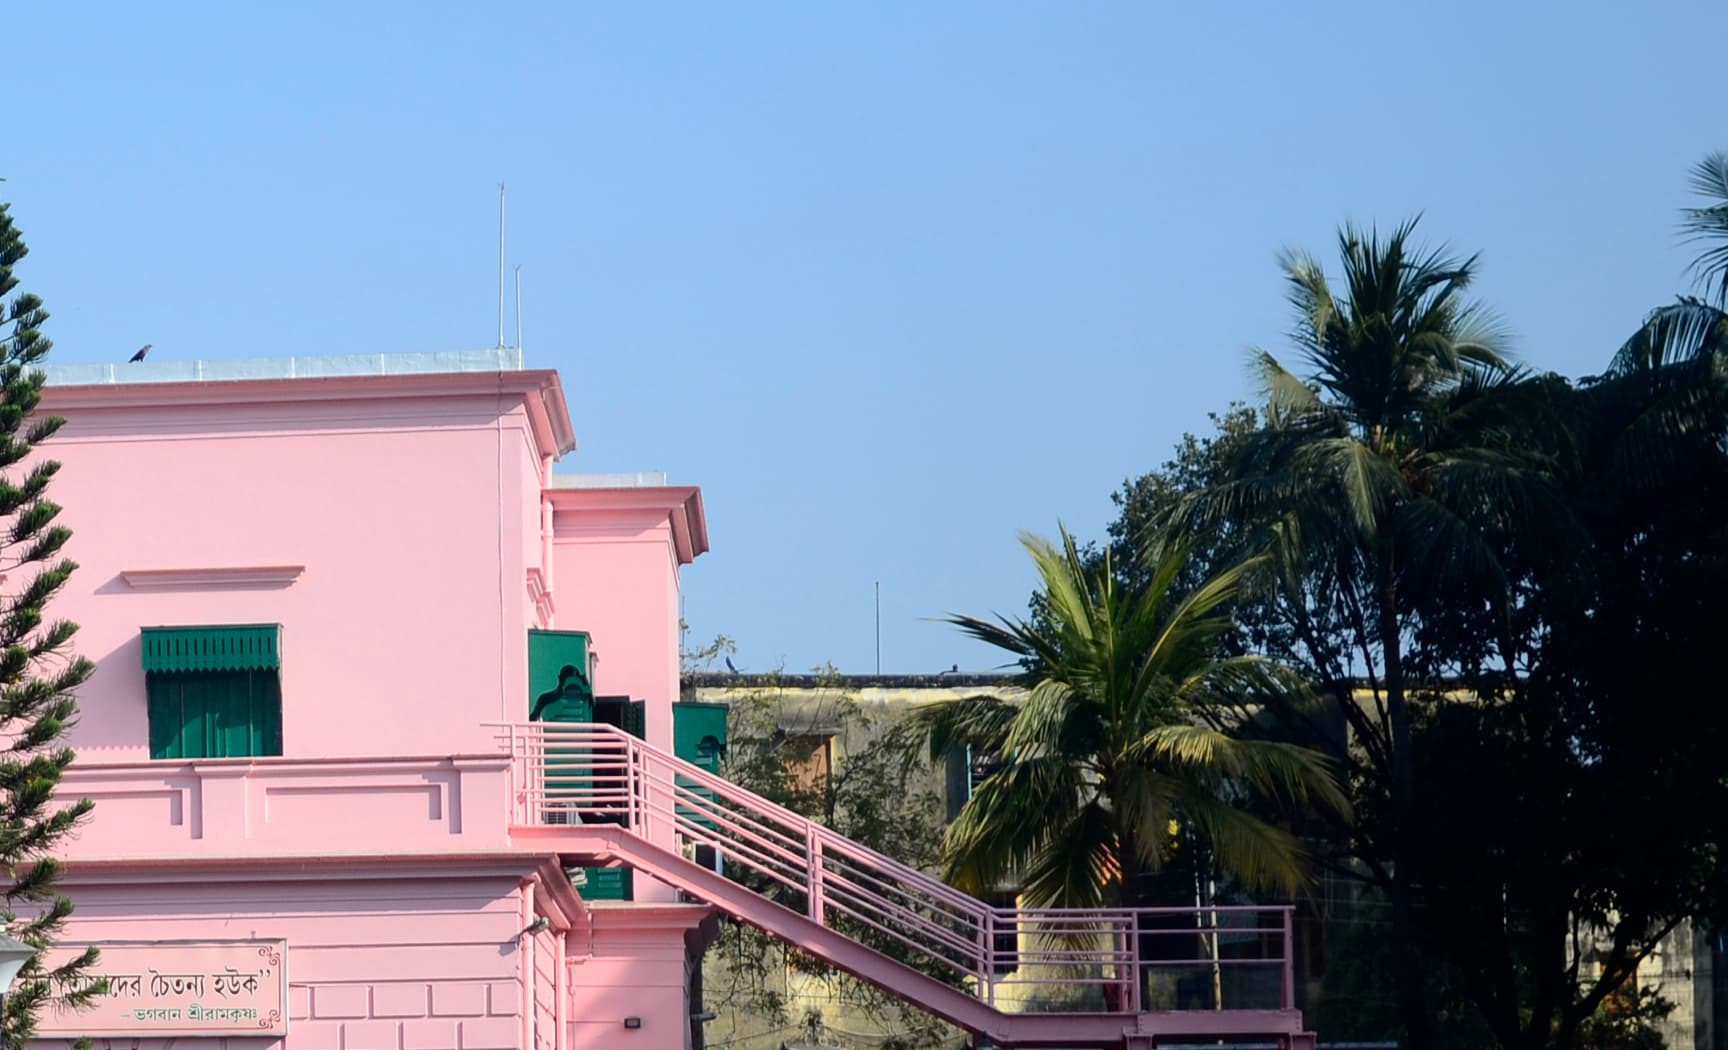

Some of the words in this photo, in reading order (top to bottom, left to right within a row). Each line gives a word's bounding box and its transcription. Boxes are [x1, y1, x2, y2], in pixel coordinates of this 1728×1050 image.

[59, 974, 141, 997] তোাদের
[148, 968, 204, 997] চৈতন্য
[134, 1008, 181, 1021] ভগবান
[188, 1003, 258, 1023] শ্রীরামকৃষ্ণ
